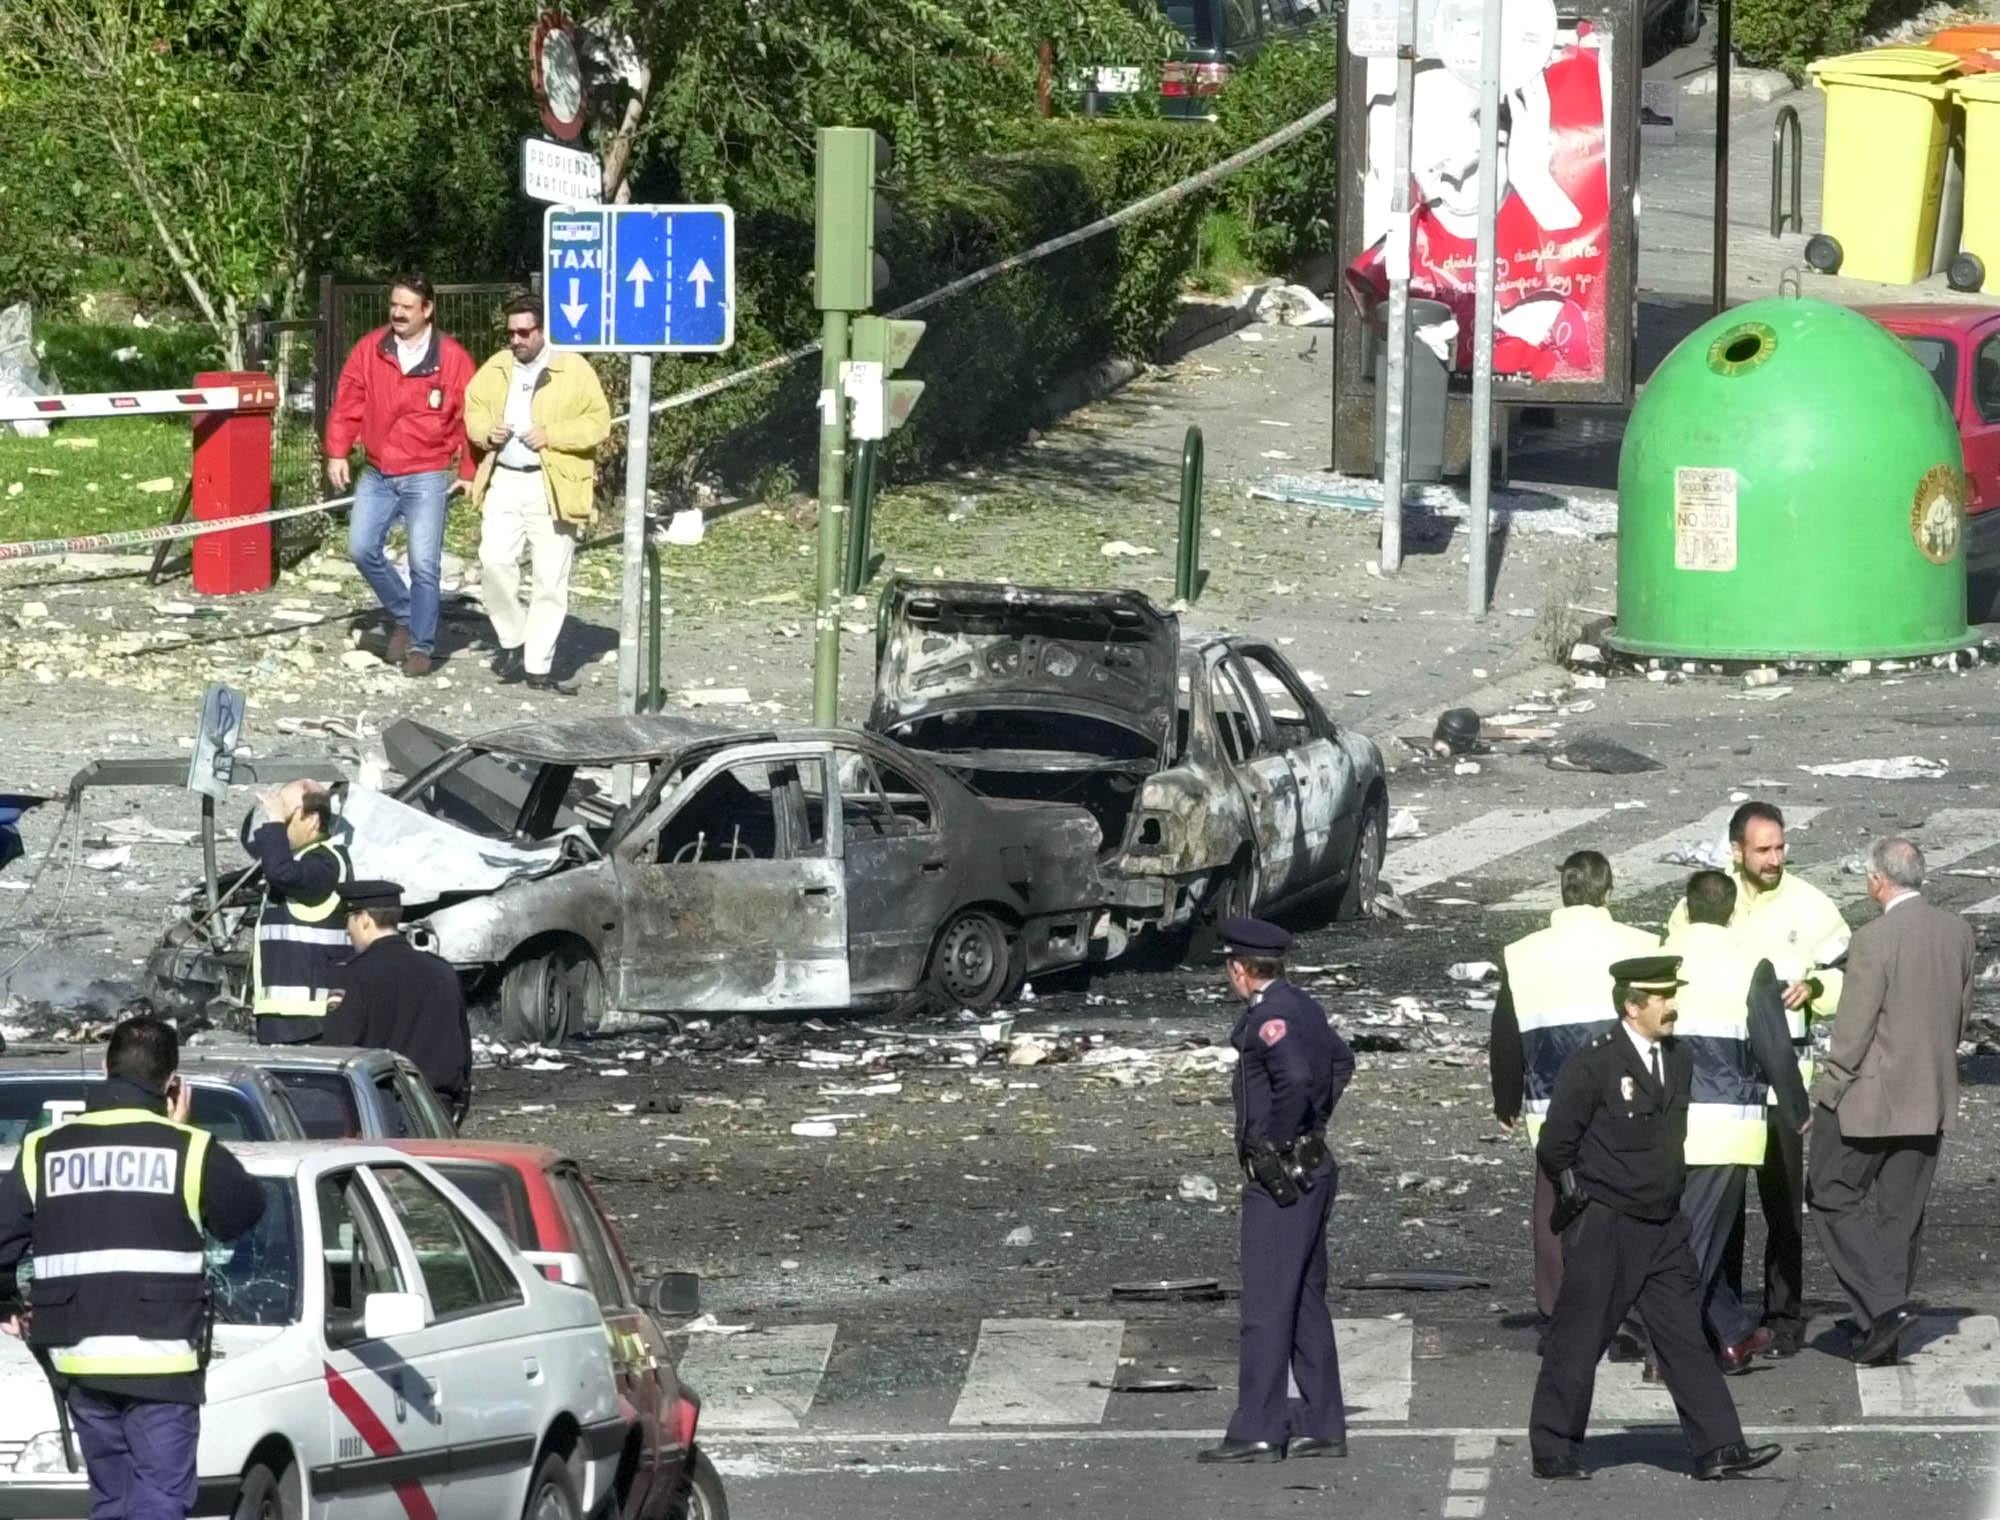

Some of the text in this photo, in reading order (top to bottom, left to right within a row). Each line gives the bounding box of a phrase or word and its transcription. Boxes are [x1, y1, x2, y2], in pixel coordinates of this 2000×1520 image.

[530, 148, 596, 179] PROPIEDAD
[550, 249, 601, 270] TAXI
[1678, 511, 1698, 528] NO
[49, 1150, 169, 1193] POLICIA
